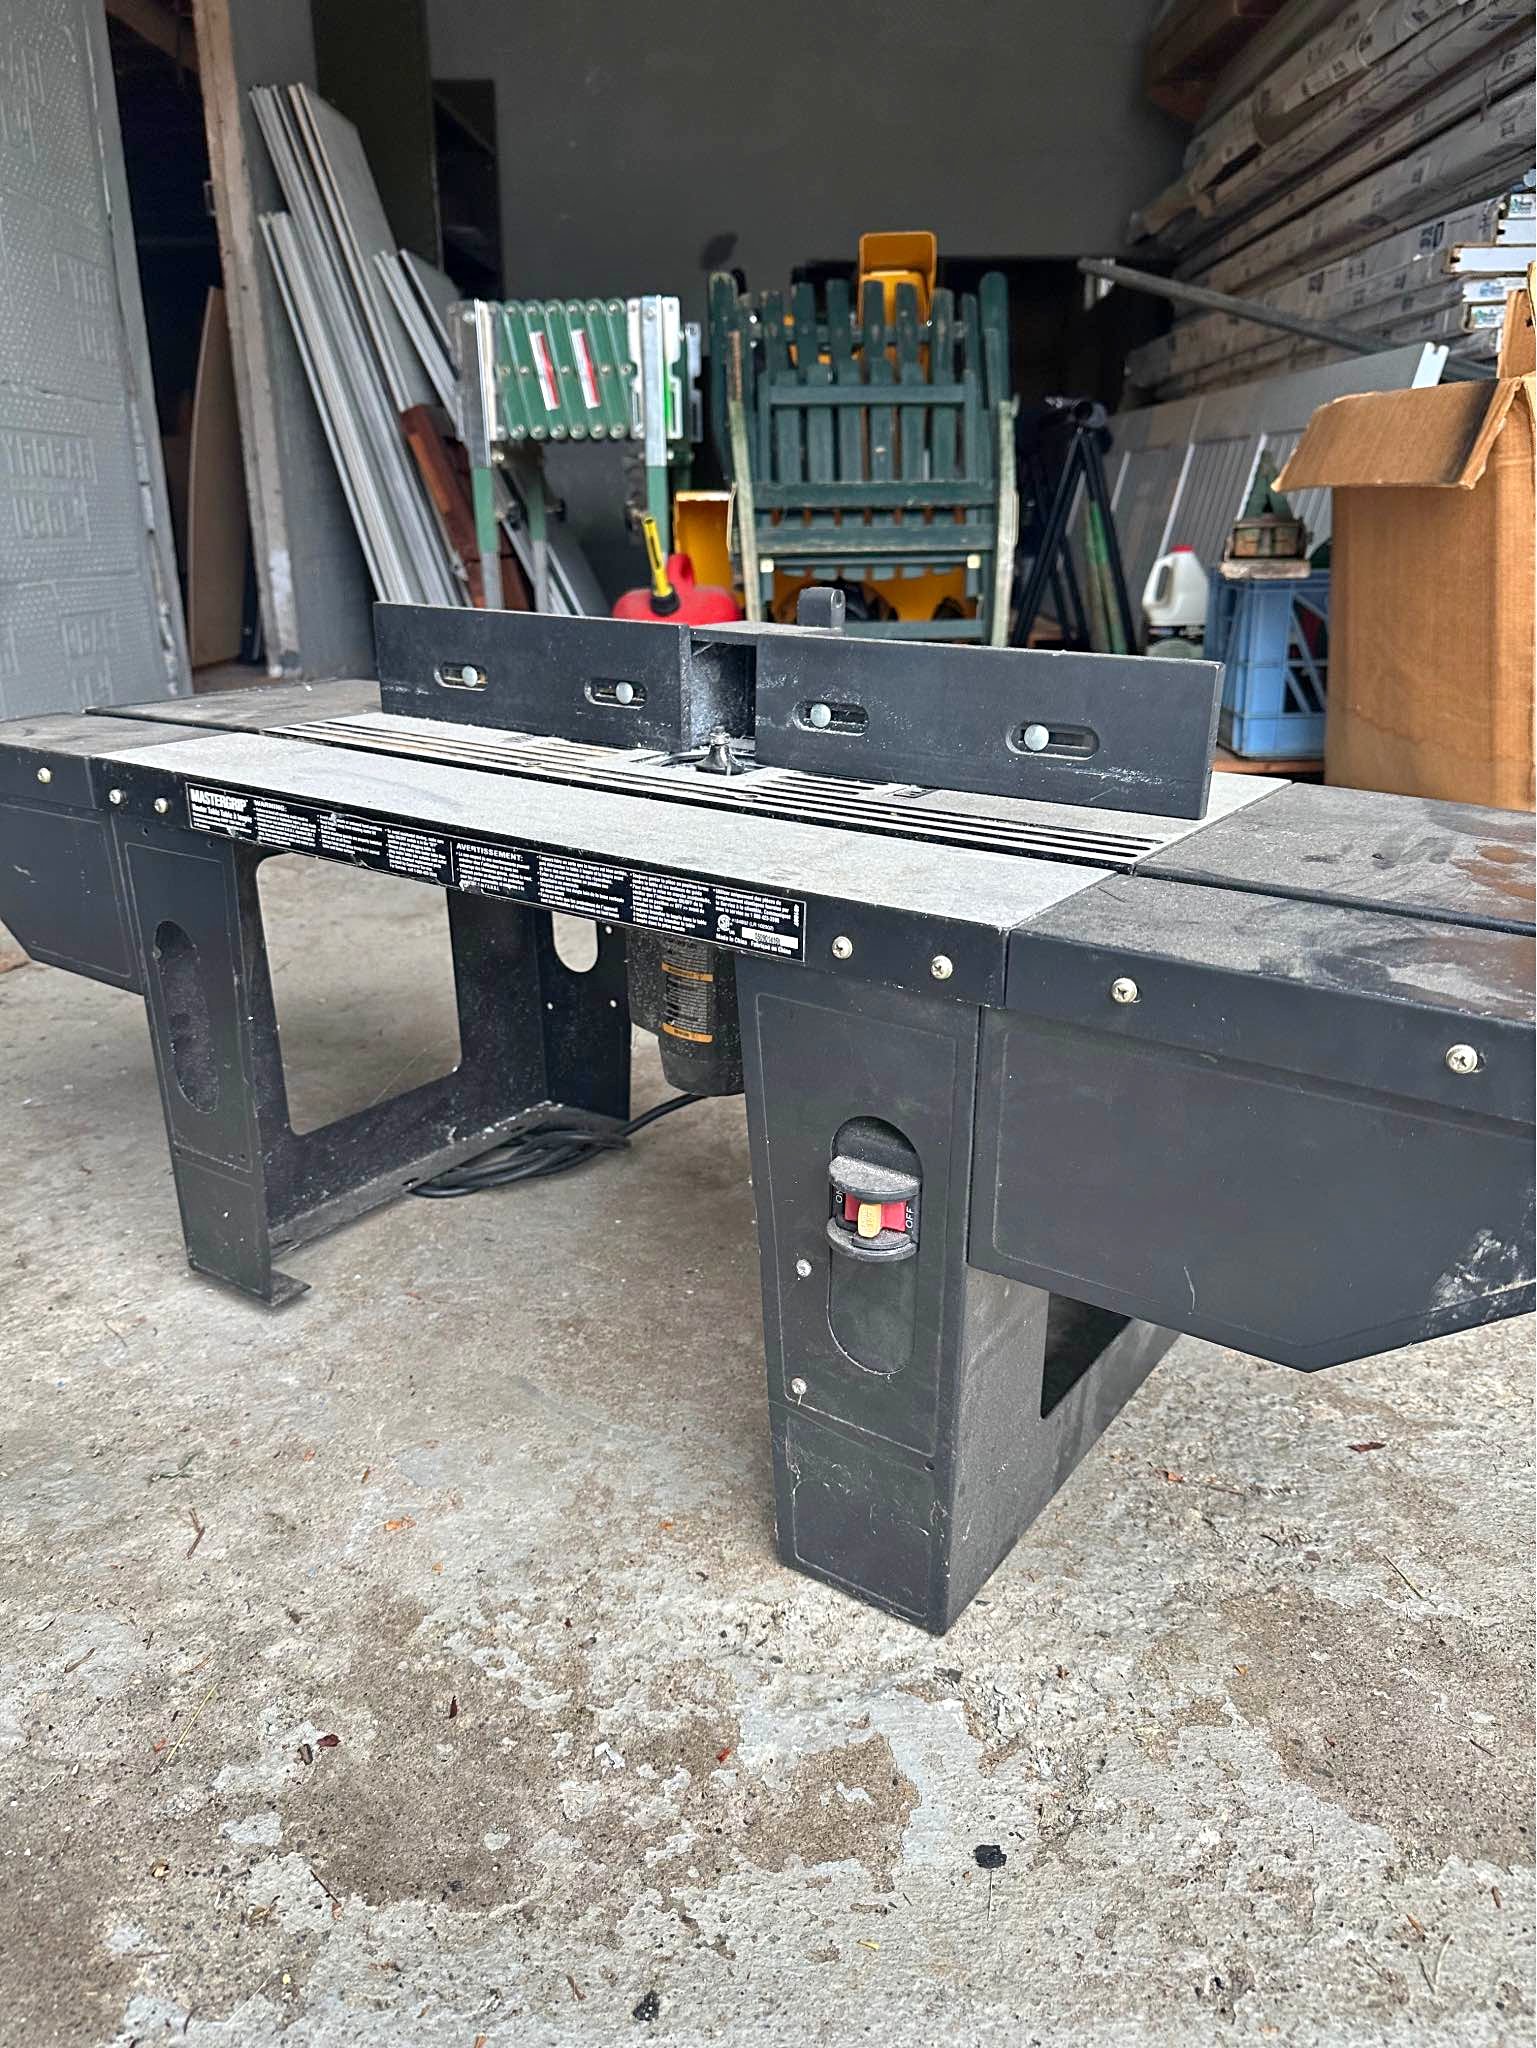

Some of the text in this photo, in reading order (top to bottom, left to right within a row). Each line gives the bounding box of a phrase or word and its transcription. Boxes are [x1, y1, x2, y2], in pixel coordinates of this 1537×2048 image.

[190, 788, 247, 812] MASTERGRIP
[456, 842, 523, 862] AVERTISSEMENT:
[905, 1206, 914, 1229] OFF
